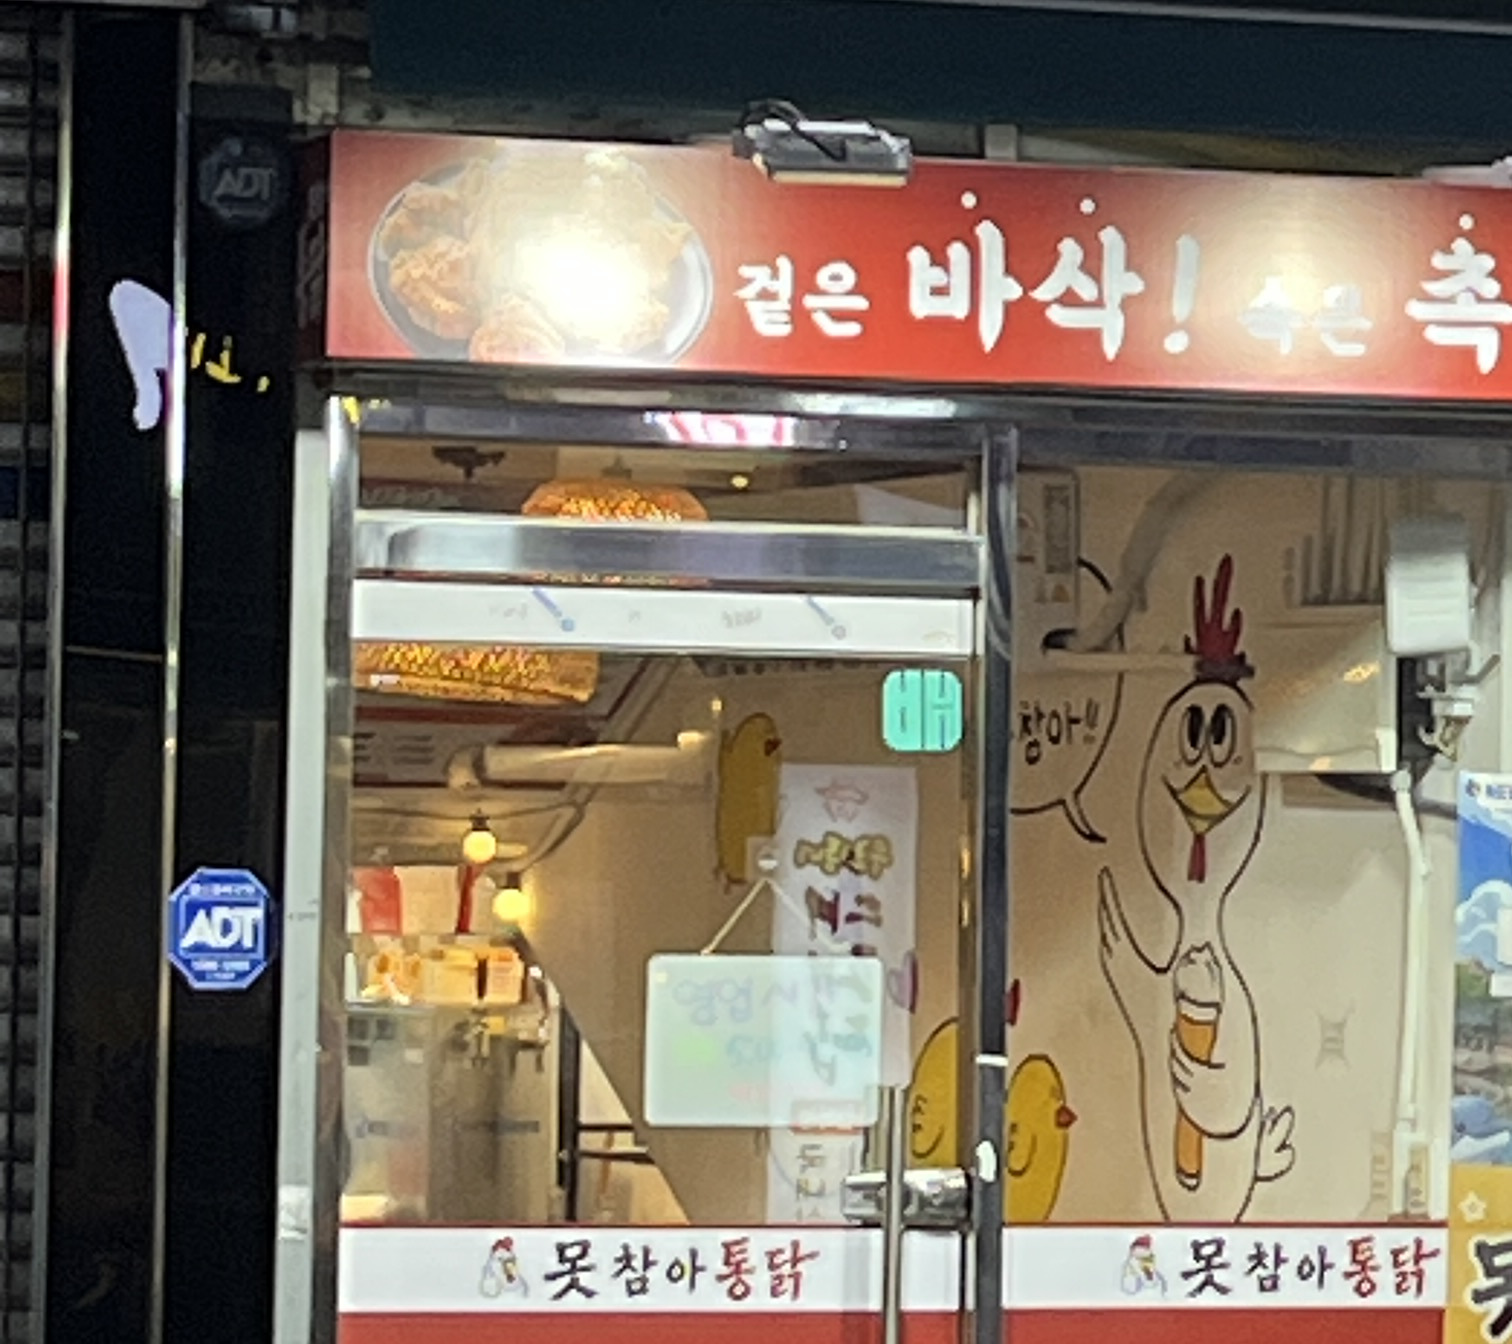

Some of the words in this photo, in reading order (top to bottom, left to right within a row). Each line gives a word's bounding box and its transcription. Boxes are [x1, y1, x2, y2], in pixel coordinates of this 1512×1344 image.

[213, 166, 277, 201] ADT
[733, 256, 868, 340] 겉은
[907, 217, 1200, 362] 바삭!
[179, 905, 264, 950] ADT
